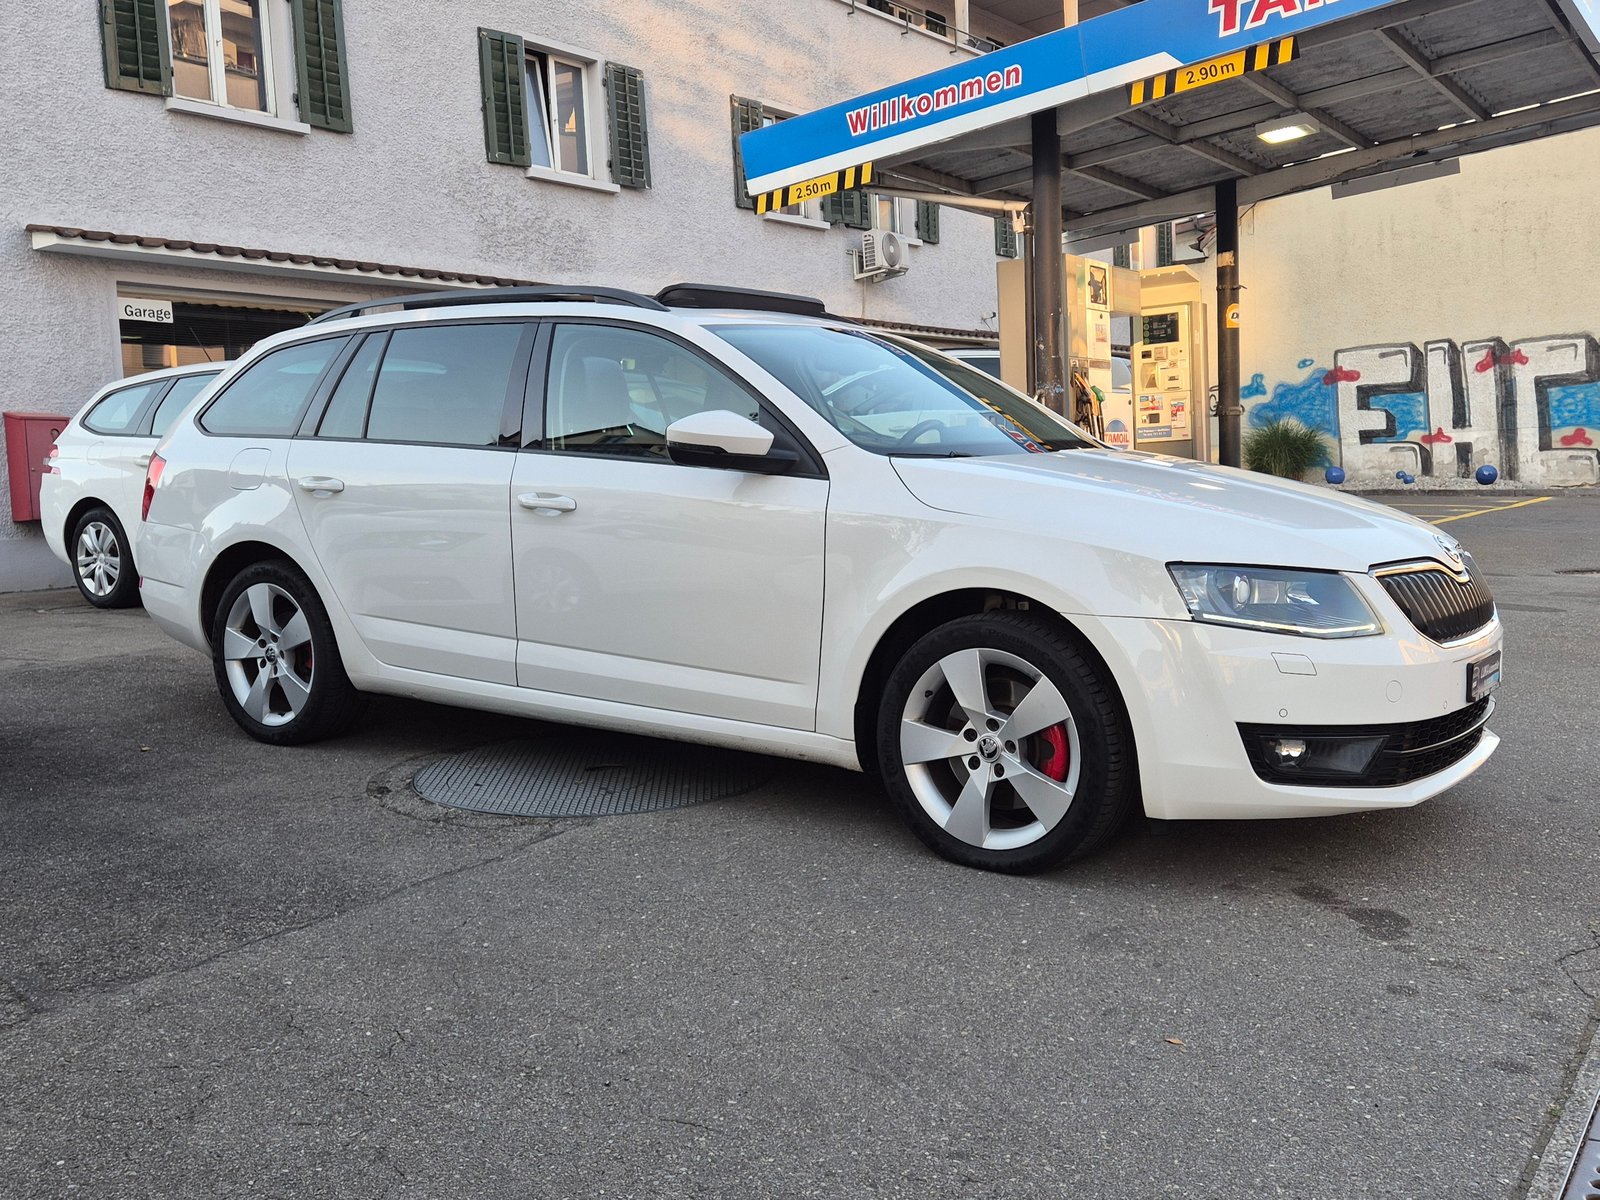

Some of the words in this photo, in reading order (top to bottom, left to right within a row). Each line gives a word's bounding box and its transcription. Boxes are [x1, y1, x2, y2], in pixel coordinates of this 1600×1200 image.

[1208, 0, 1341, 38] TA
[846, 64, 1022, 136] Willkommen
[124, 304, 171, 321] Garage
[1104, 433, 1129, 444] TAMOIL
